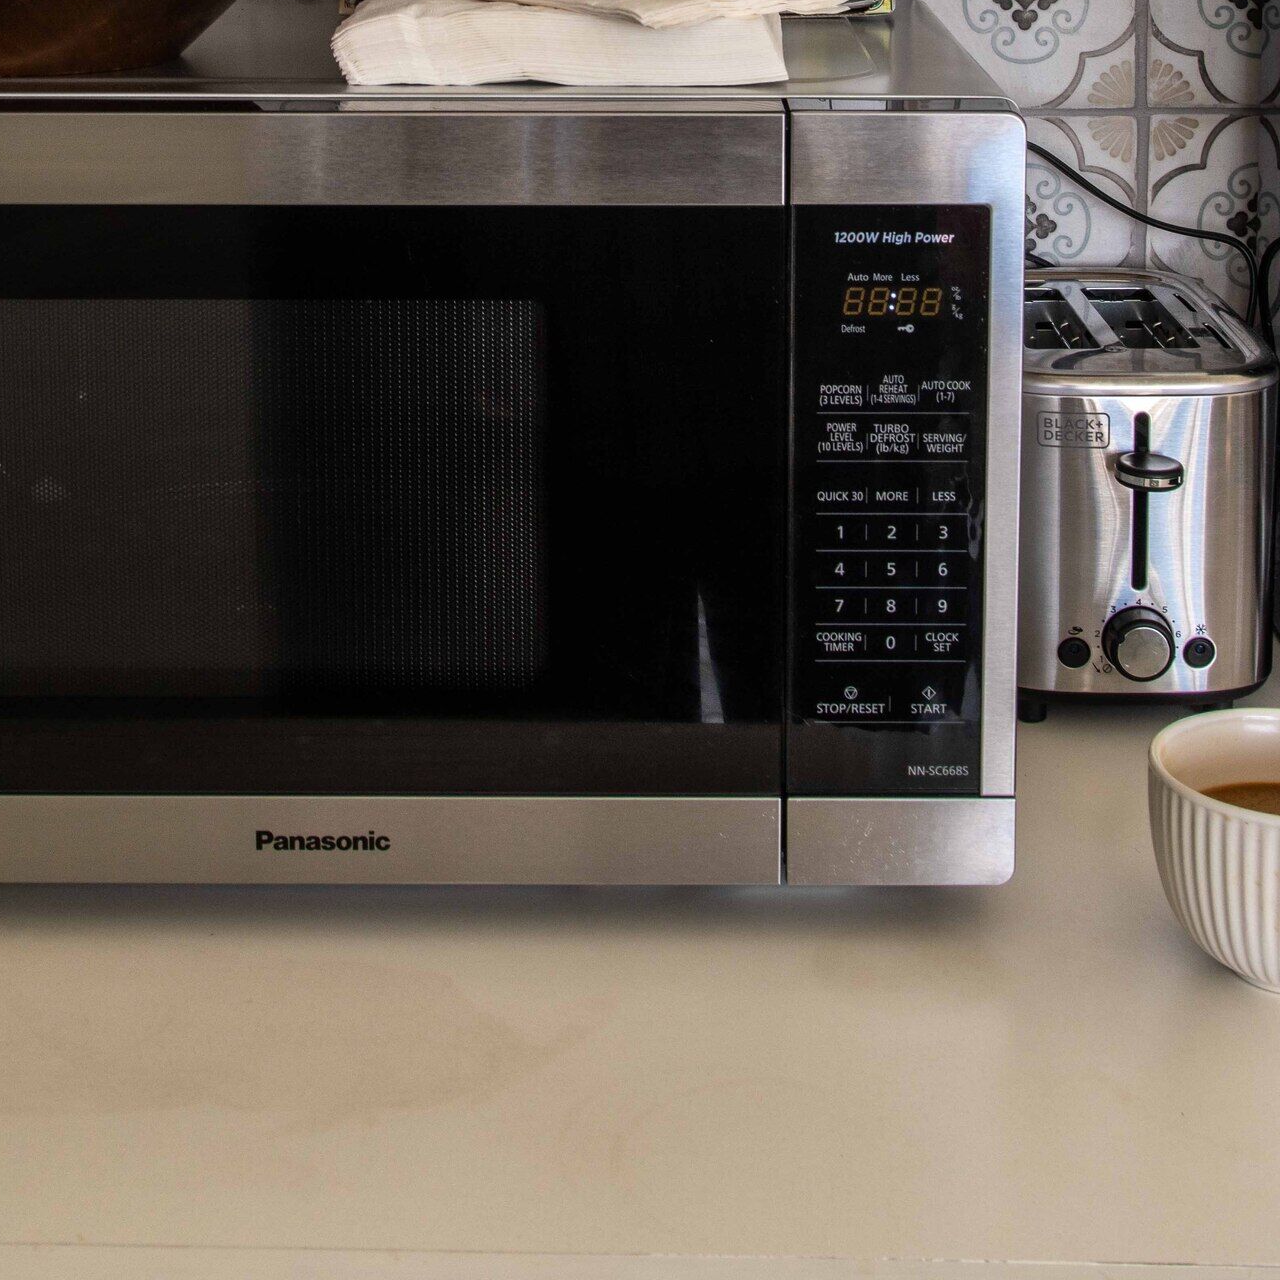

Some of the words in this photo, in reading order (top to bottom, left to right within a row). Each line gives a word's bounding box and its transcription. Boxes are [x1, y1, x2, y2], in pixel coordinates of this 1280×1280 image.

[834, 231, 878, 244] 1200W
[882, 231, 912, 245] High
[915, 231, 955, 244] Power
[847, 273, 869, 282] Auto
[872, 273, 893, 282] More
[901, 273, 920, 282] Less
[841, 324, 866, 333] Defrost
[882, 374, 905, 384] AUTO
[921, 380, 946, 390] AUTO
[946, 380, 971, 390] COOK
[820, 384, 862, 394] POPCORN
[879, 384, 908, 394] REHEAT
[819, 395, 828, 407] (3
[830, 395, 863, 407] LEVELS)
[935, 391, 955, 403] (1-7)
[826, 422, 857, 432] POWER
[873, 423, 909, 433] TURBO
[1043, 417, 1104, 430] BLACK+
[830, 432, 854, 442] LEVEL
[870, 433, 916, 443] DEFROST
[922, 433, 967, 443] SERVING/
[1043, 429, 1105, 443] DECKER
[817, 442, 830, 453] (10
[832, 442, 864, 453] LEVELS)
[875, 443, 909, 455] (lb/kg)
[926, 443, 964, 453] WEIGHT
[817, 491, 850, 503] QUICK
[851, 491, 864, 502] 30
[875, 491, 909, 502] MORE
[932, 491, 956, 502] LESS
[836, 525, 844, 540] 1
[887, 525, 897, 540] 2
[938, 525, 949, 540] 3
[834, 562, 845, 576] 4
[886, 562, 897, 576] 5
[938, 562, 949, 576] 6
[834, 599, 844, 613] 7
[886, 599, 897, 613] 8
[937, 599, 948, 613] 9
[1135, 598, 1142, 606] 4
[1110, 605, 1117, 614] 3
[816, 631, 862, 643] COOKING
[925, 631, 959, 643] CLOCK
[1094, 630, 1101, 638] 2
[1175, 630, 1182, 638] 6
[823, 641, 855, 653] TIMER
[885, 636, 896, 650] 0
[933, 641, 952, 653] SET
[1099, 655, 1103, 663] 1
[816, 702, 886, 714] STOP/RESET
[910, 702, 948, 714] START
[255, 830, 391, 851] Panasonic
